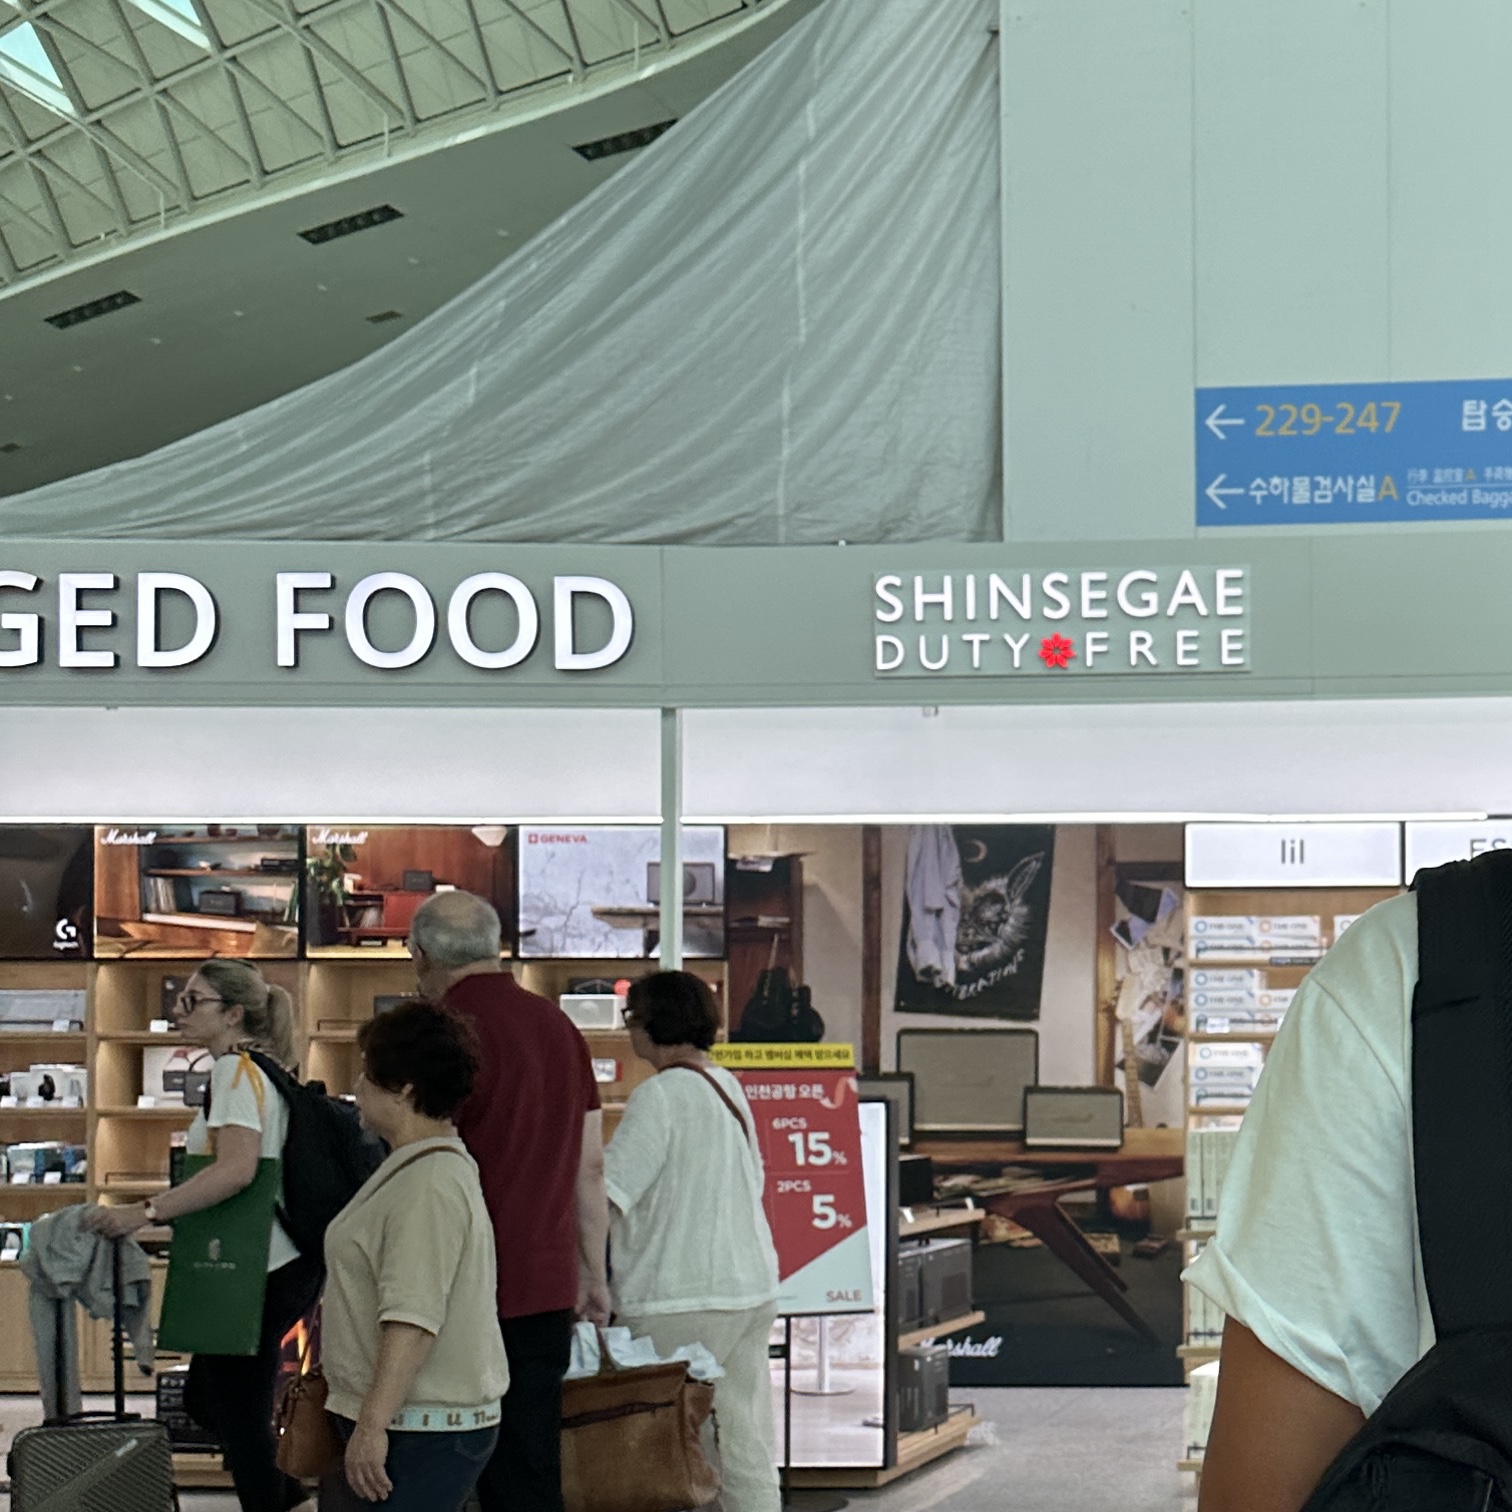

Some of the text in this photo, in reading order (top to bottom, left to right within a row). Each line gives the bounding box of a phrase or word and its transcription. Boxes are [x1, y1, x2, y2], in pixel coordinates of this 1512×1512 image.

[1254, 402, 1401, 437] 229-247
[874, 568, 1246, 623] SHINSEGAE
[275, 570, 635, 671] FOOD
[874, 628, 1246, 671] DUTY FREE
[745, 1083, 797, 1100] 인천공항
[772, 1117, 808, 1130] 6PCS
[788, 1132, 848, 1167] 15%
[777, 1180, 811, 1193] 2PCS
[811, 1194, 852, 1229] 5%
[826, 1289, 863, 1302] SALE
[919, 1335, 1003, 1358] rshall
